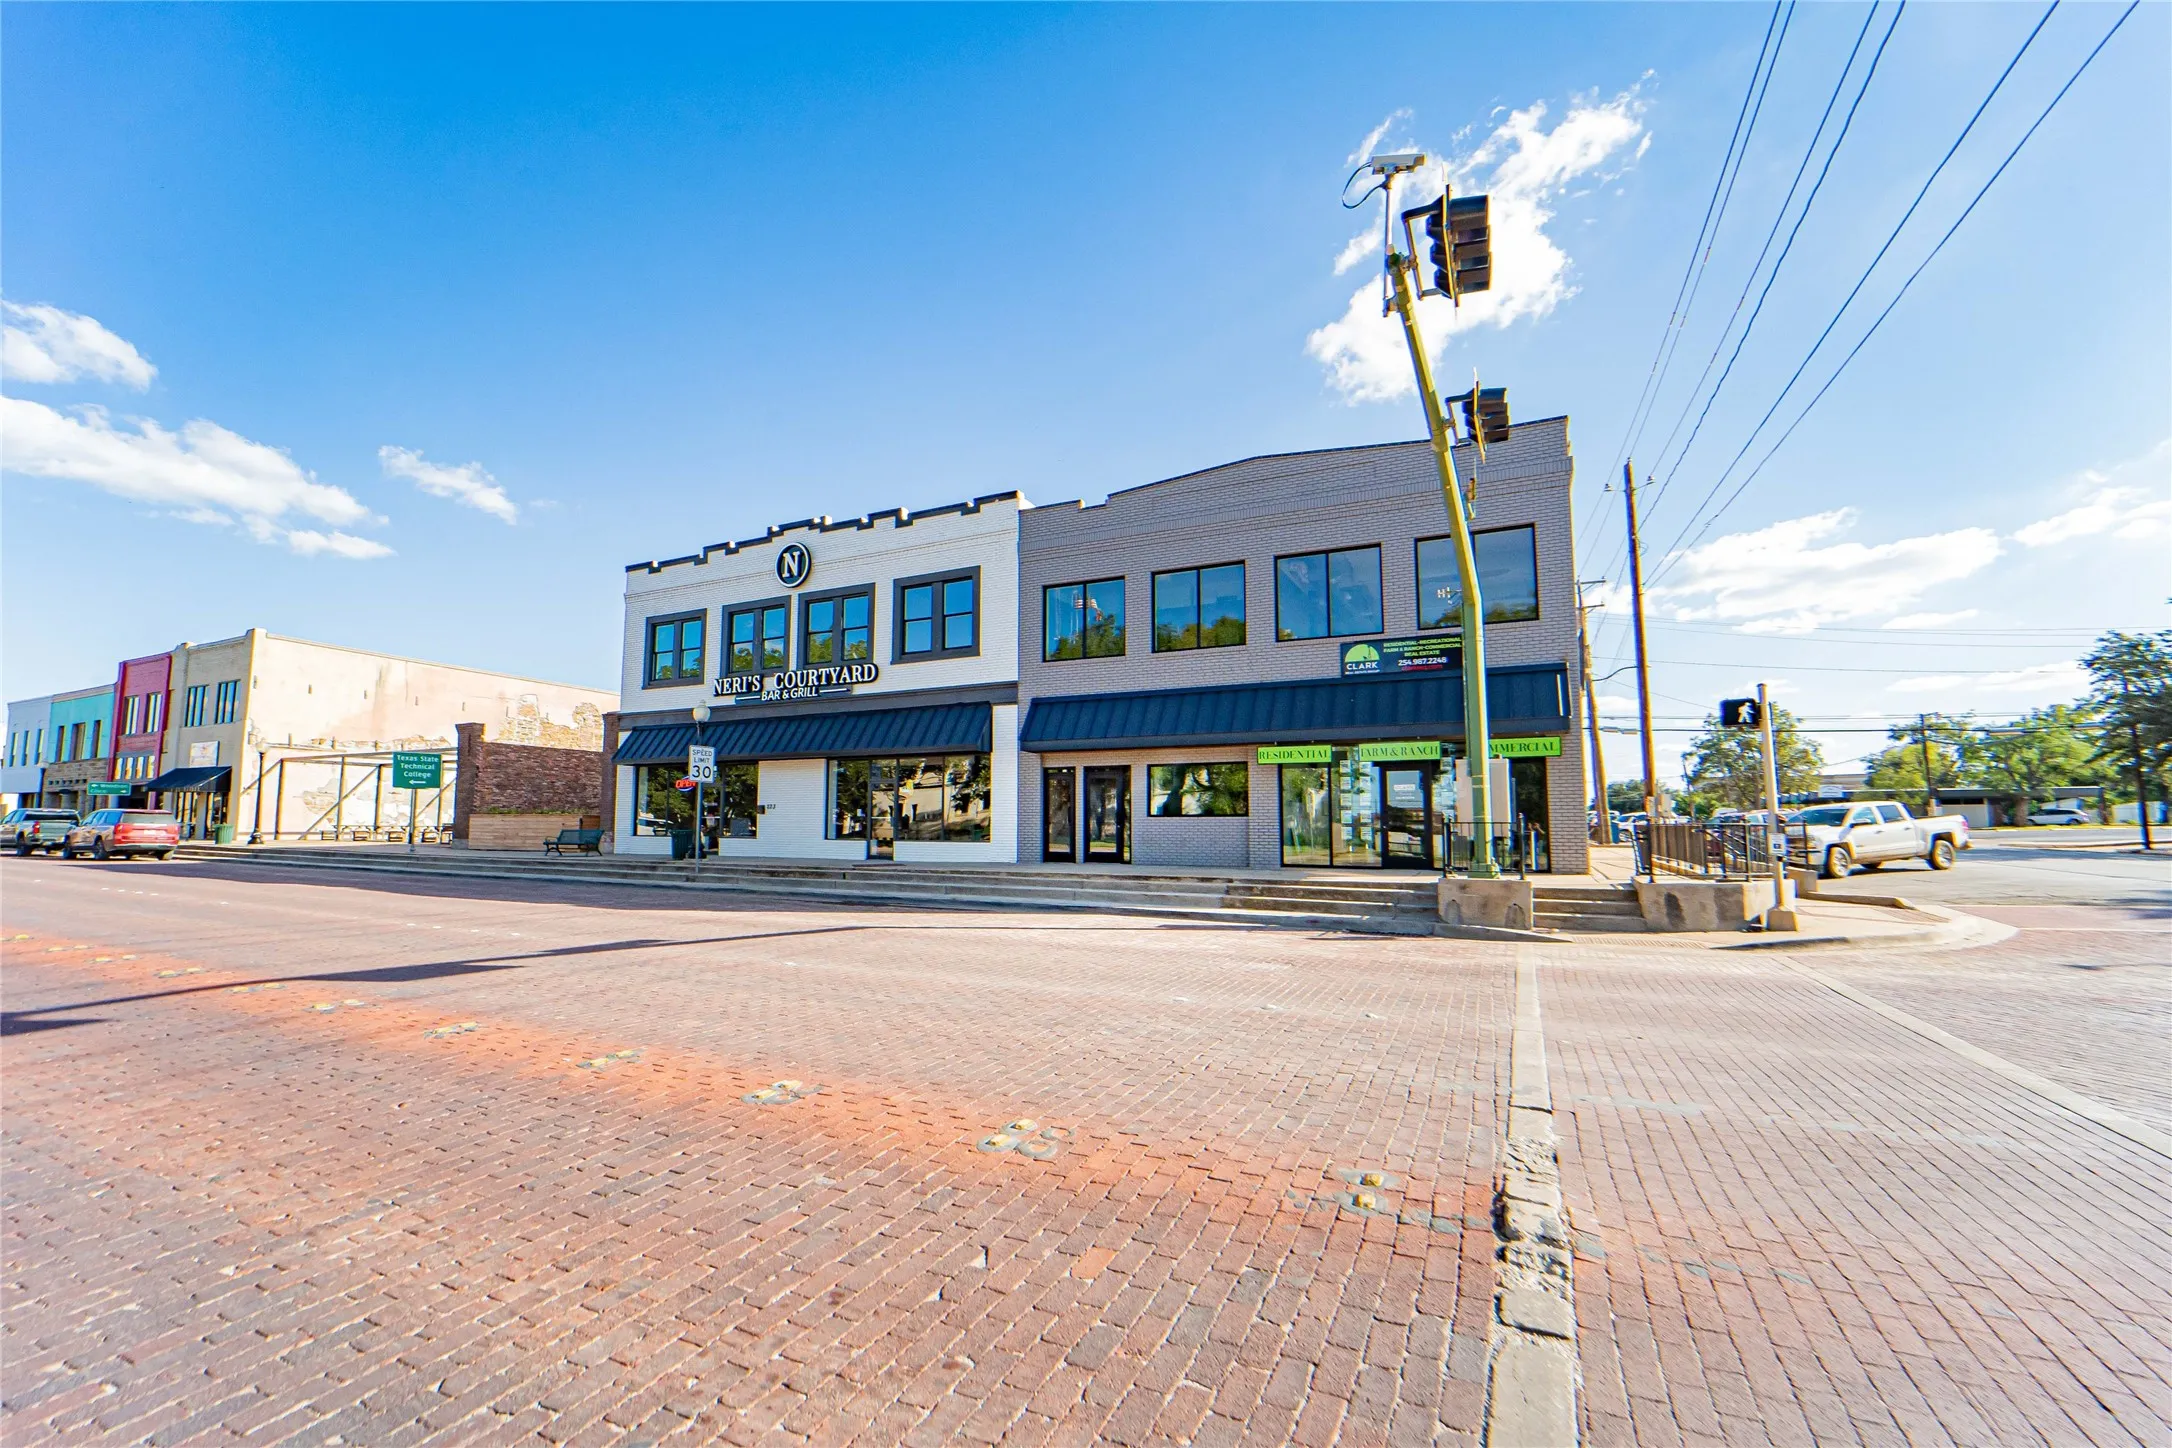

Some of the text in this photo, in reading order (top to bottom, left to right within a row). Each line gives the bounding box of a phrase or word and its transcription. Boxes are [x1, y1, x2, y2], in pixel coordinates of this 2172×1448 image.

[783, 551, 800, 578] N
[1346, 661, 1378, 670] CLARK
[713, 664, 876, 695] NERI'S COURTYARD
[761, 686, 818, 701] BAR & GRILL
[1489, 742, 1556, 752] MMERCIAL
[1259, 749, 1328, 759] RESIDENTIAL
[403, 771, 431, 779] College
[692, 765, 712, 778] 30
[675, 779, 696, 788] OPEN
